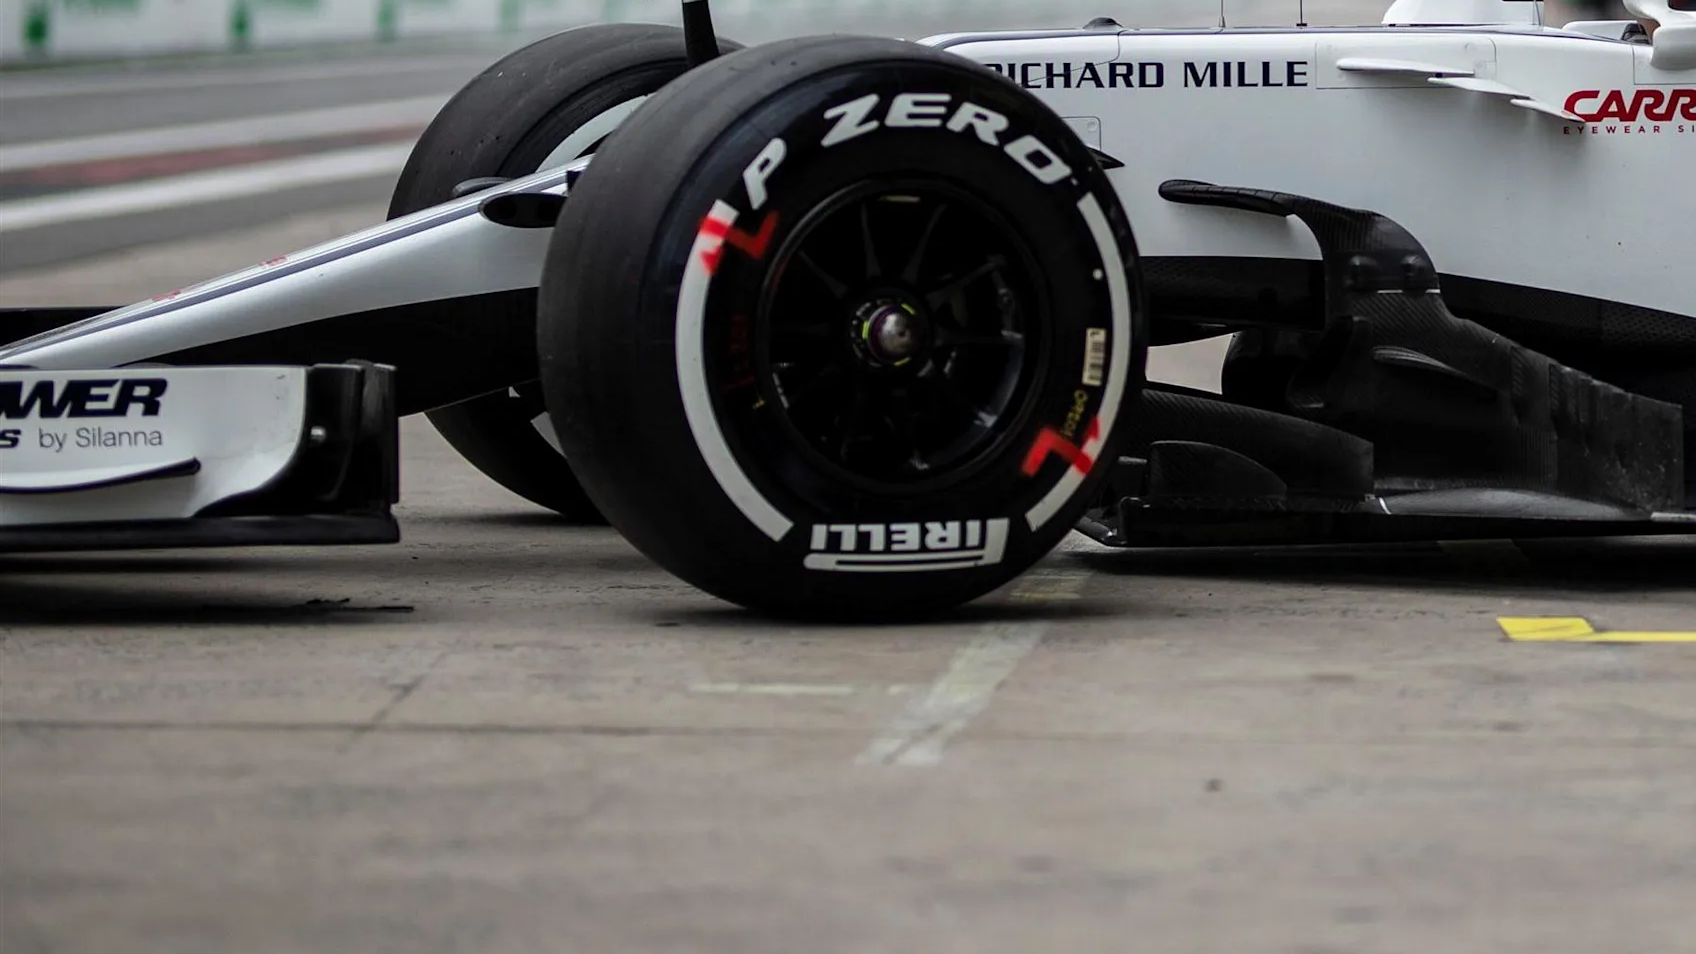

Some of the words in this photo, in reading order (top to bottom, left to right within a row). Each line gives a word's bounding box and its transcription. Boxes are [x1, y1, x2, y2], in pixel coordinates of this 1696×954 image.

[1183, 61, 1308, 88] MILLE
[1563, 124, 1661, 135] EYEWEAR
[743, 137, 787, 210] P
[820, 93, 1073, 184] ZERO
[0, 378, 168, 419] WER
[39, 427, 67, 453] by
[75, 427, 163, 448] Silanna
[803, 517, 1010, 572] PIRELLI
